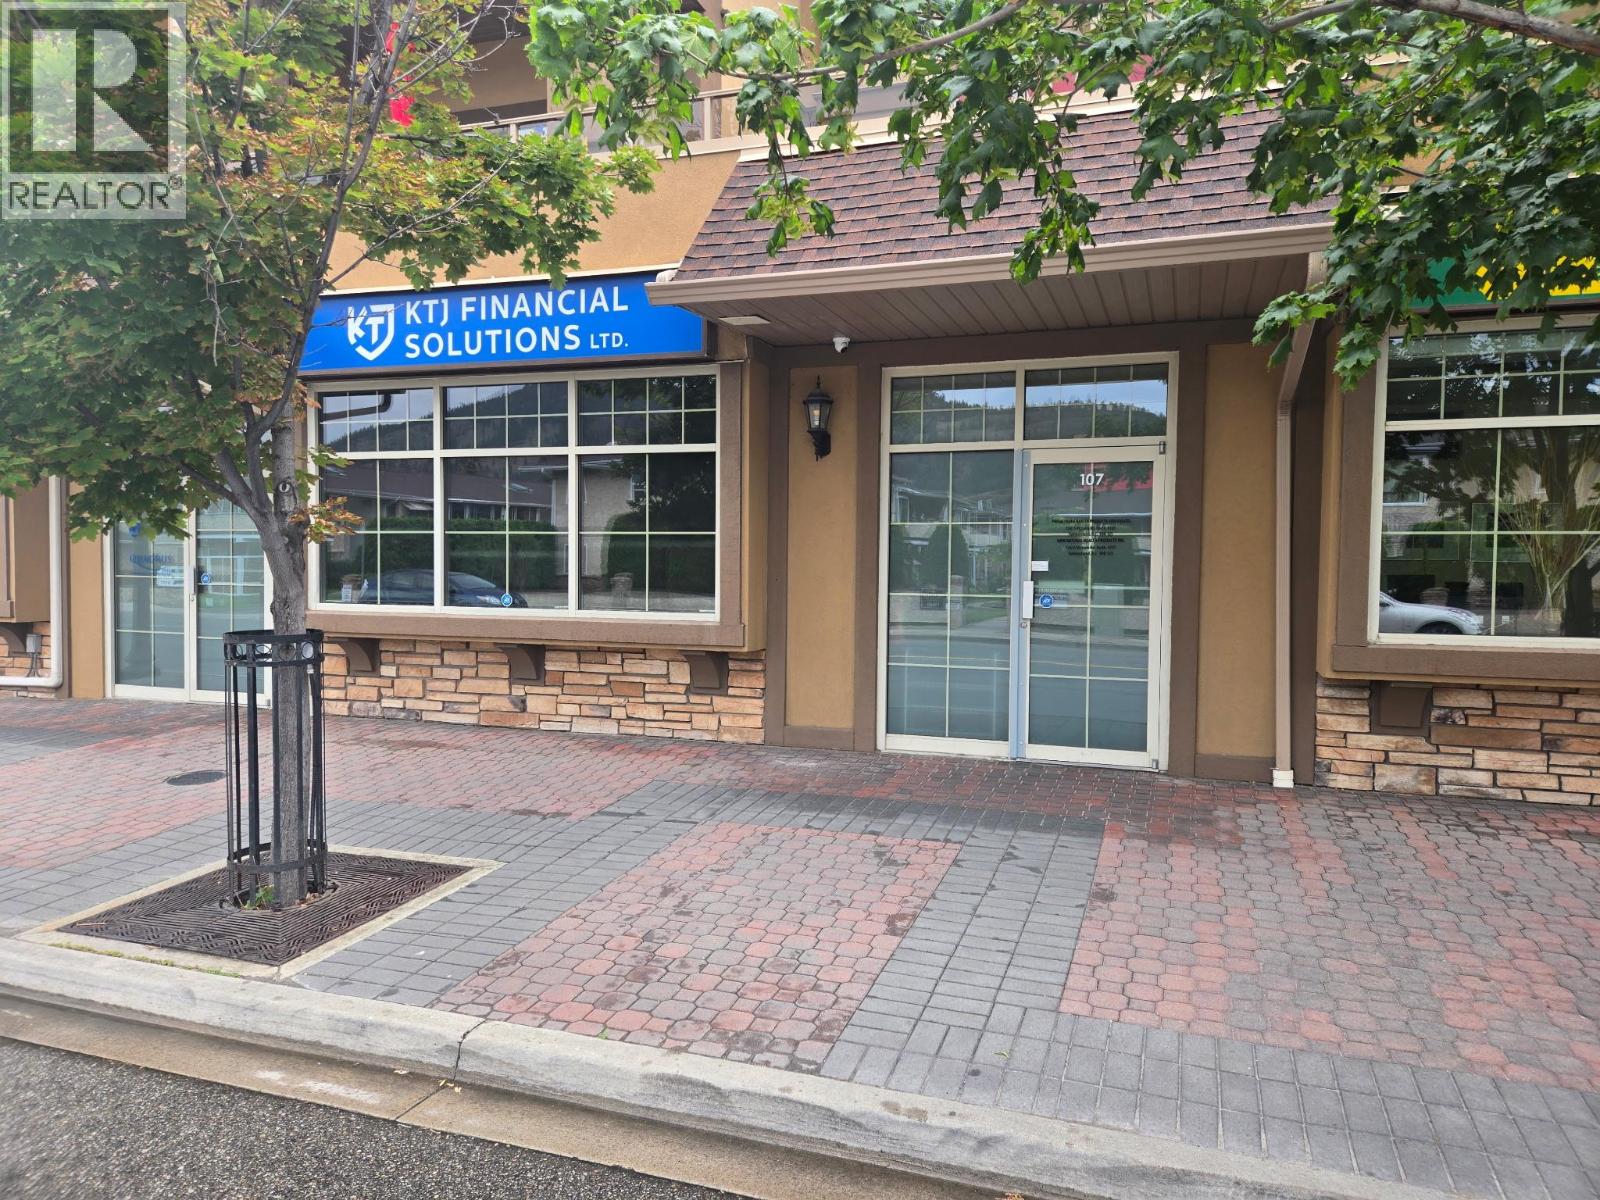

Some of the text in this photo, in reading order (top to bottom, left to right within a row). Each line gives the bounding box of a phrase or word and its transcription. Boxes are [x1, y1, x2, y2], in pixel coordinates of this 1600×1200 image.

[405, 286, 629, 327] KTJ FINANCIAL
[404, 324, 629, 359] SOLUTIONS LTD.
[1079, 473, 1105, 486] 107
